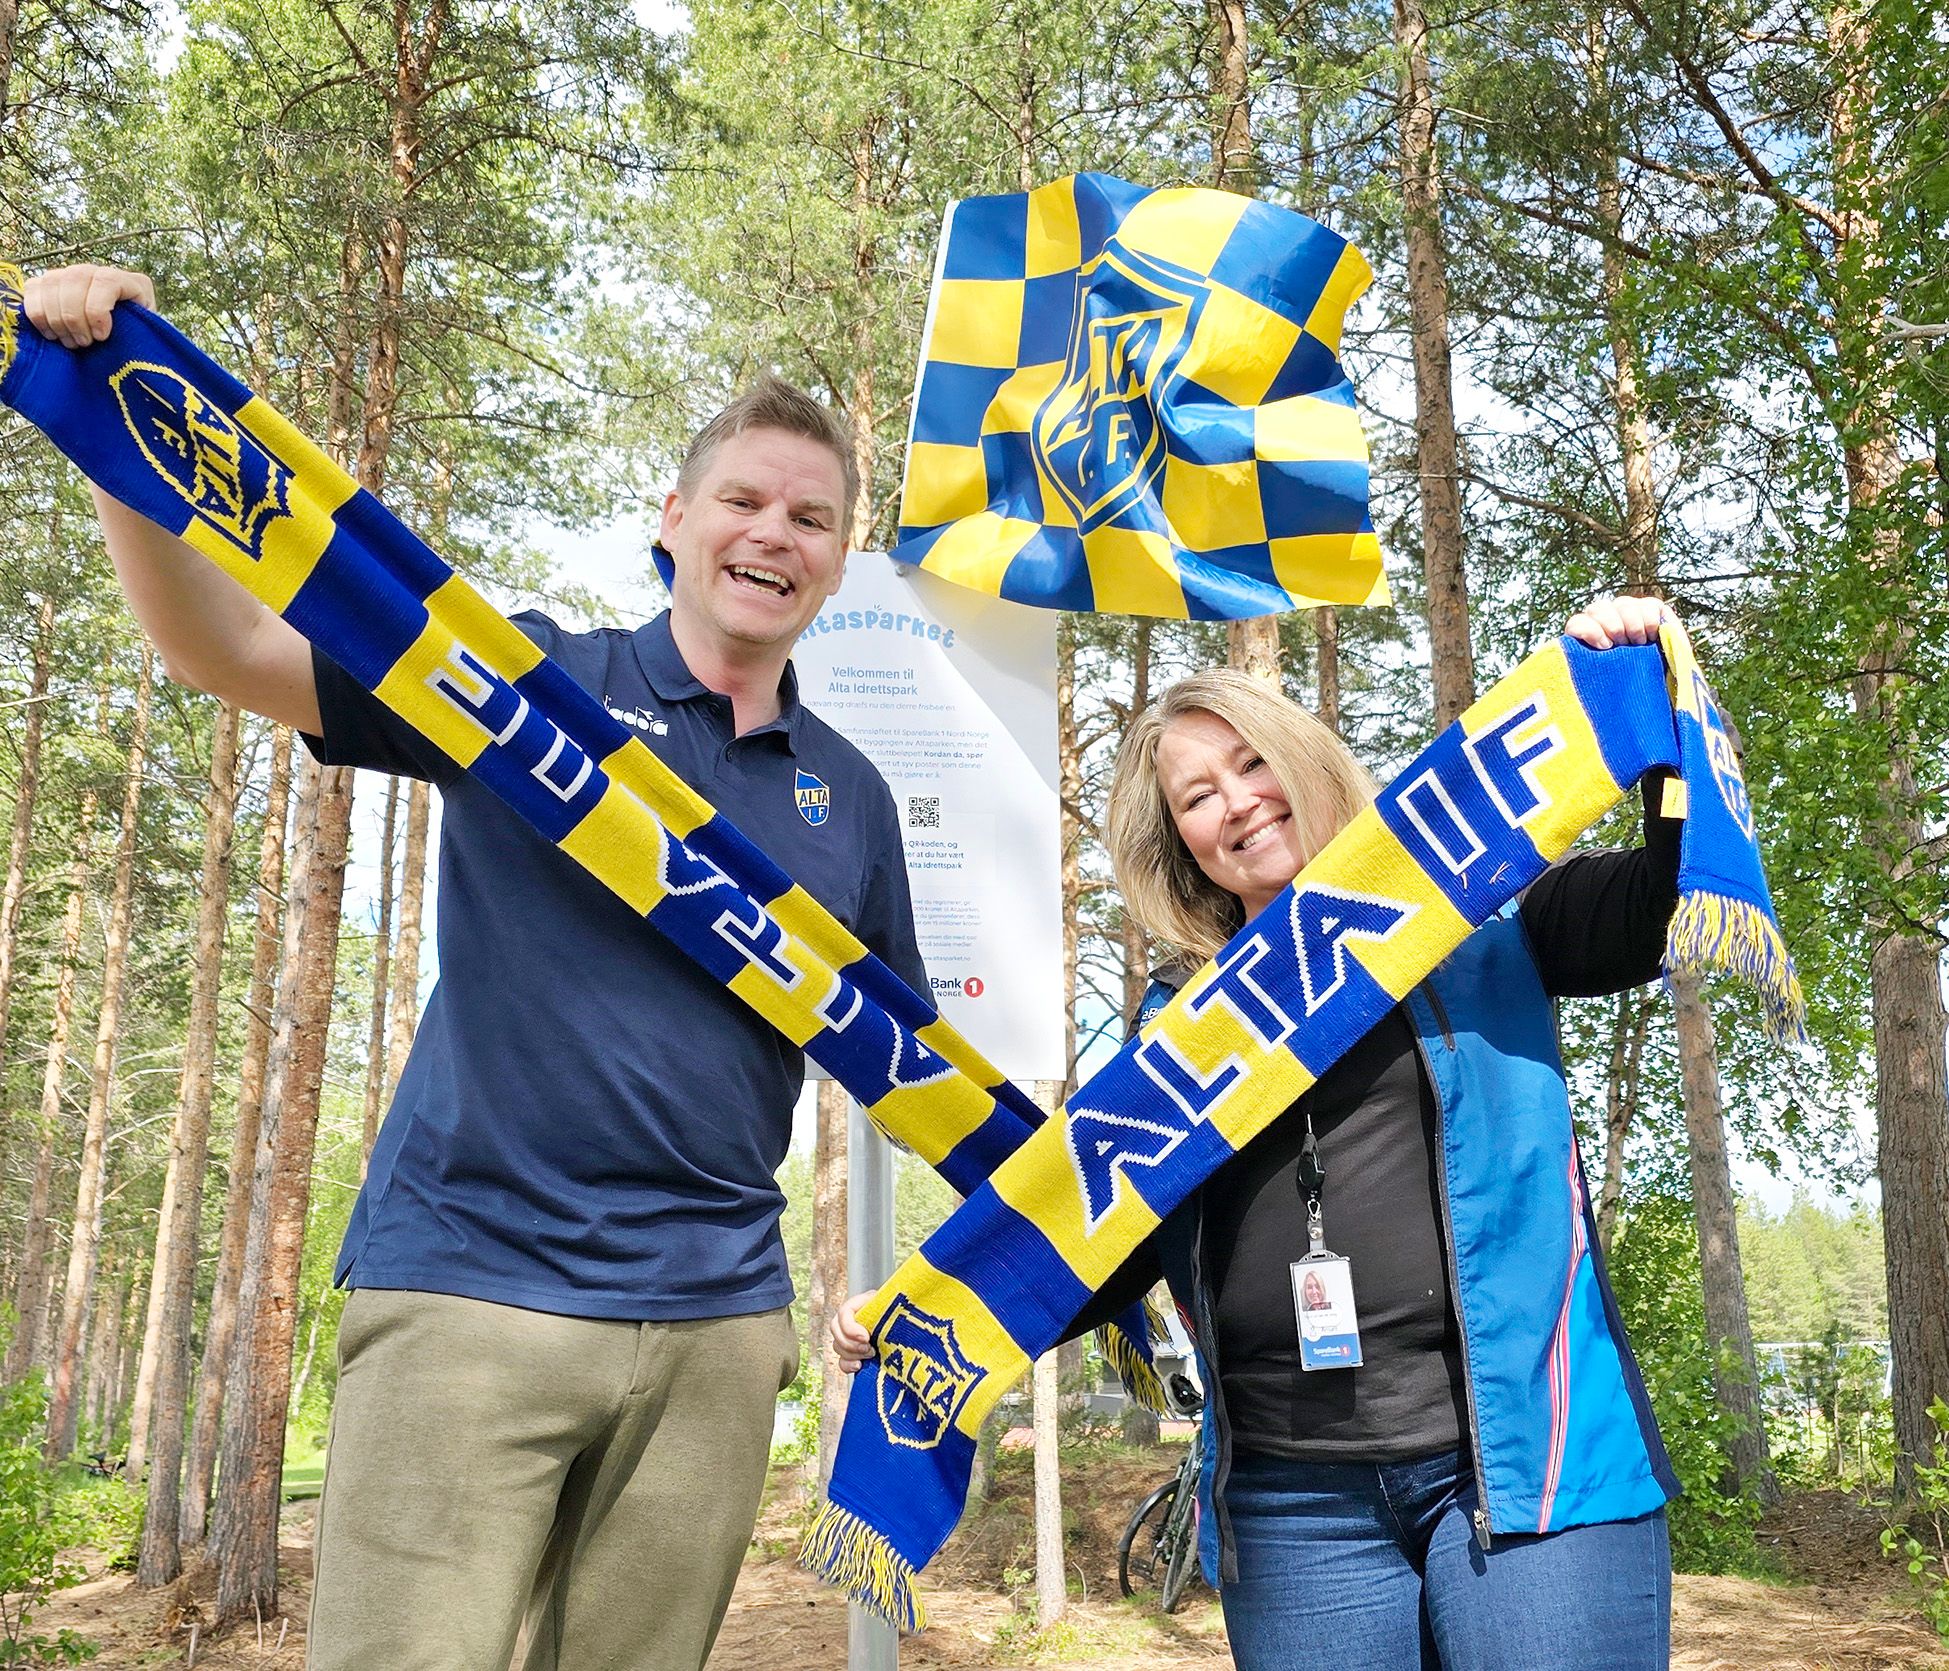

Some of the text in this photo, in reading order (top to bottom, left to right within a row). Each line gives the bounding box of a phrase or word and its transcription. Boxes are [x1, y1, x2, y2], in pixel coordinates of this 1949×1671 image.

[1046, 318, 1163, 447] ATA
[828, 682, 918, 697] Alta Idrettspark
[832, 667, 914, 680] Velkommen til
[799, 789, 829, 806] ALTA
[1064, 692, 1567, 1239] ALTA IF
[884, 1348, 958, 1418] ALTA
